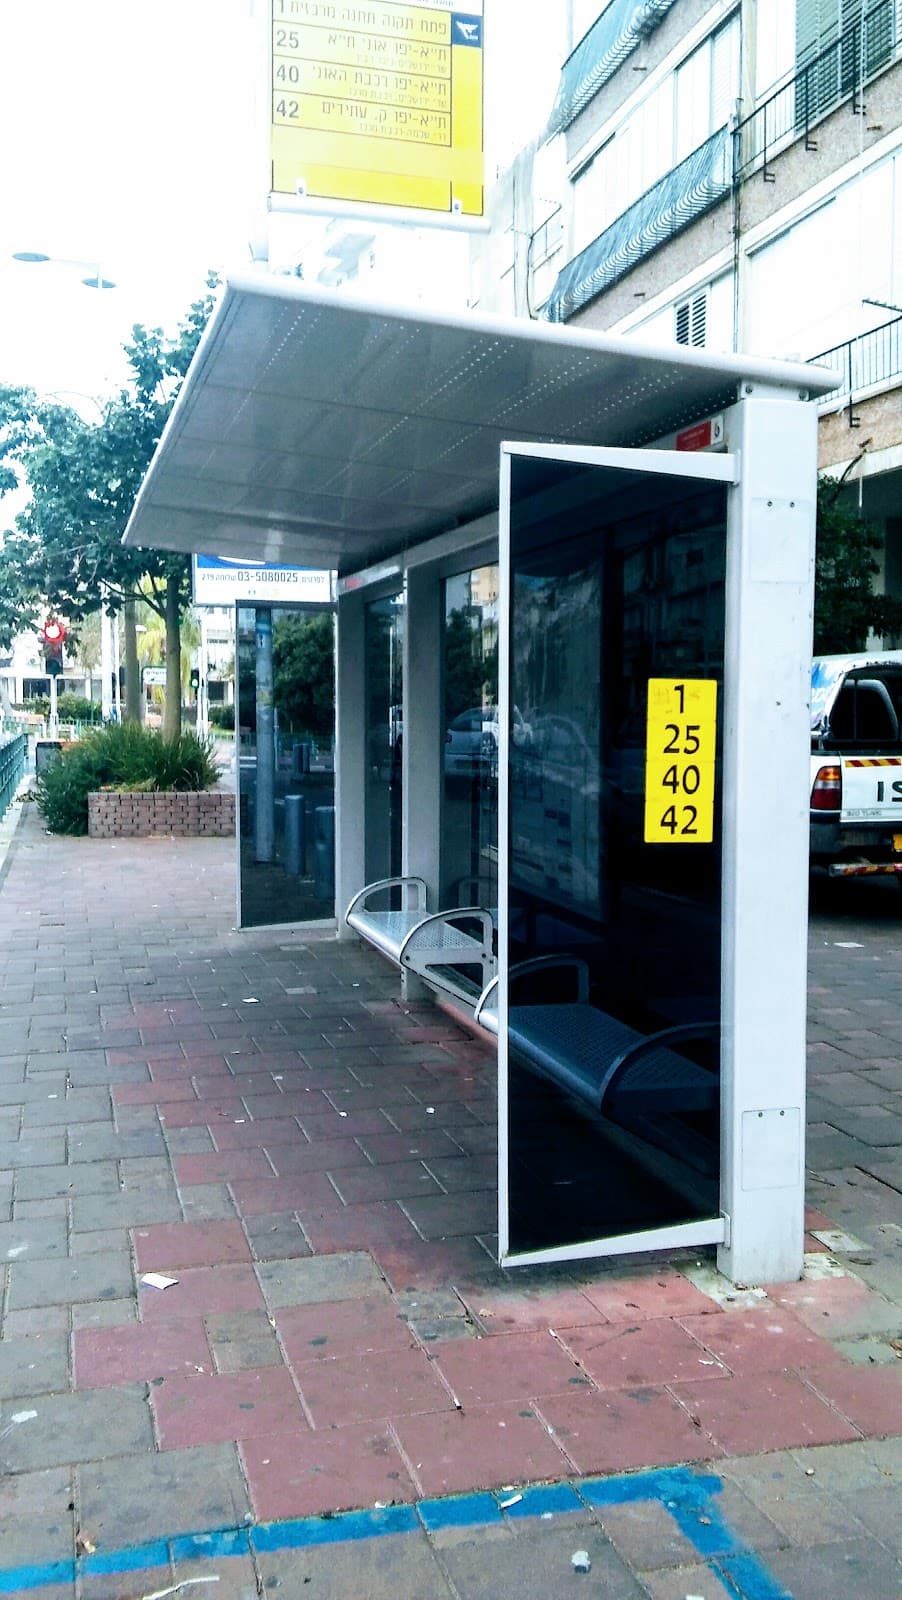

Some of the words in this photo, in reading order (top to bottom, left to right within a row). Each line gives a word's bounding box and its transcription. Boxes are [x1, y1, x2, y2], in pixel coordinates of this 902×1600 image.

[276, 30, 299, 49] 25
[276, 64, 299, 83] 40
[276, 99, 299, 119] 42
[236, 570, 299, 583] 03-5080025
[673, 683, 685, 714] 1
[662, 722, 701, 755] 25
[661, 763, 701, 795] 40
[659, 803, 699, 836] 42
